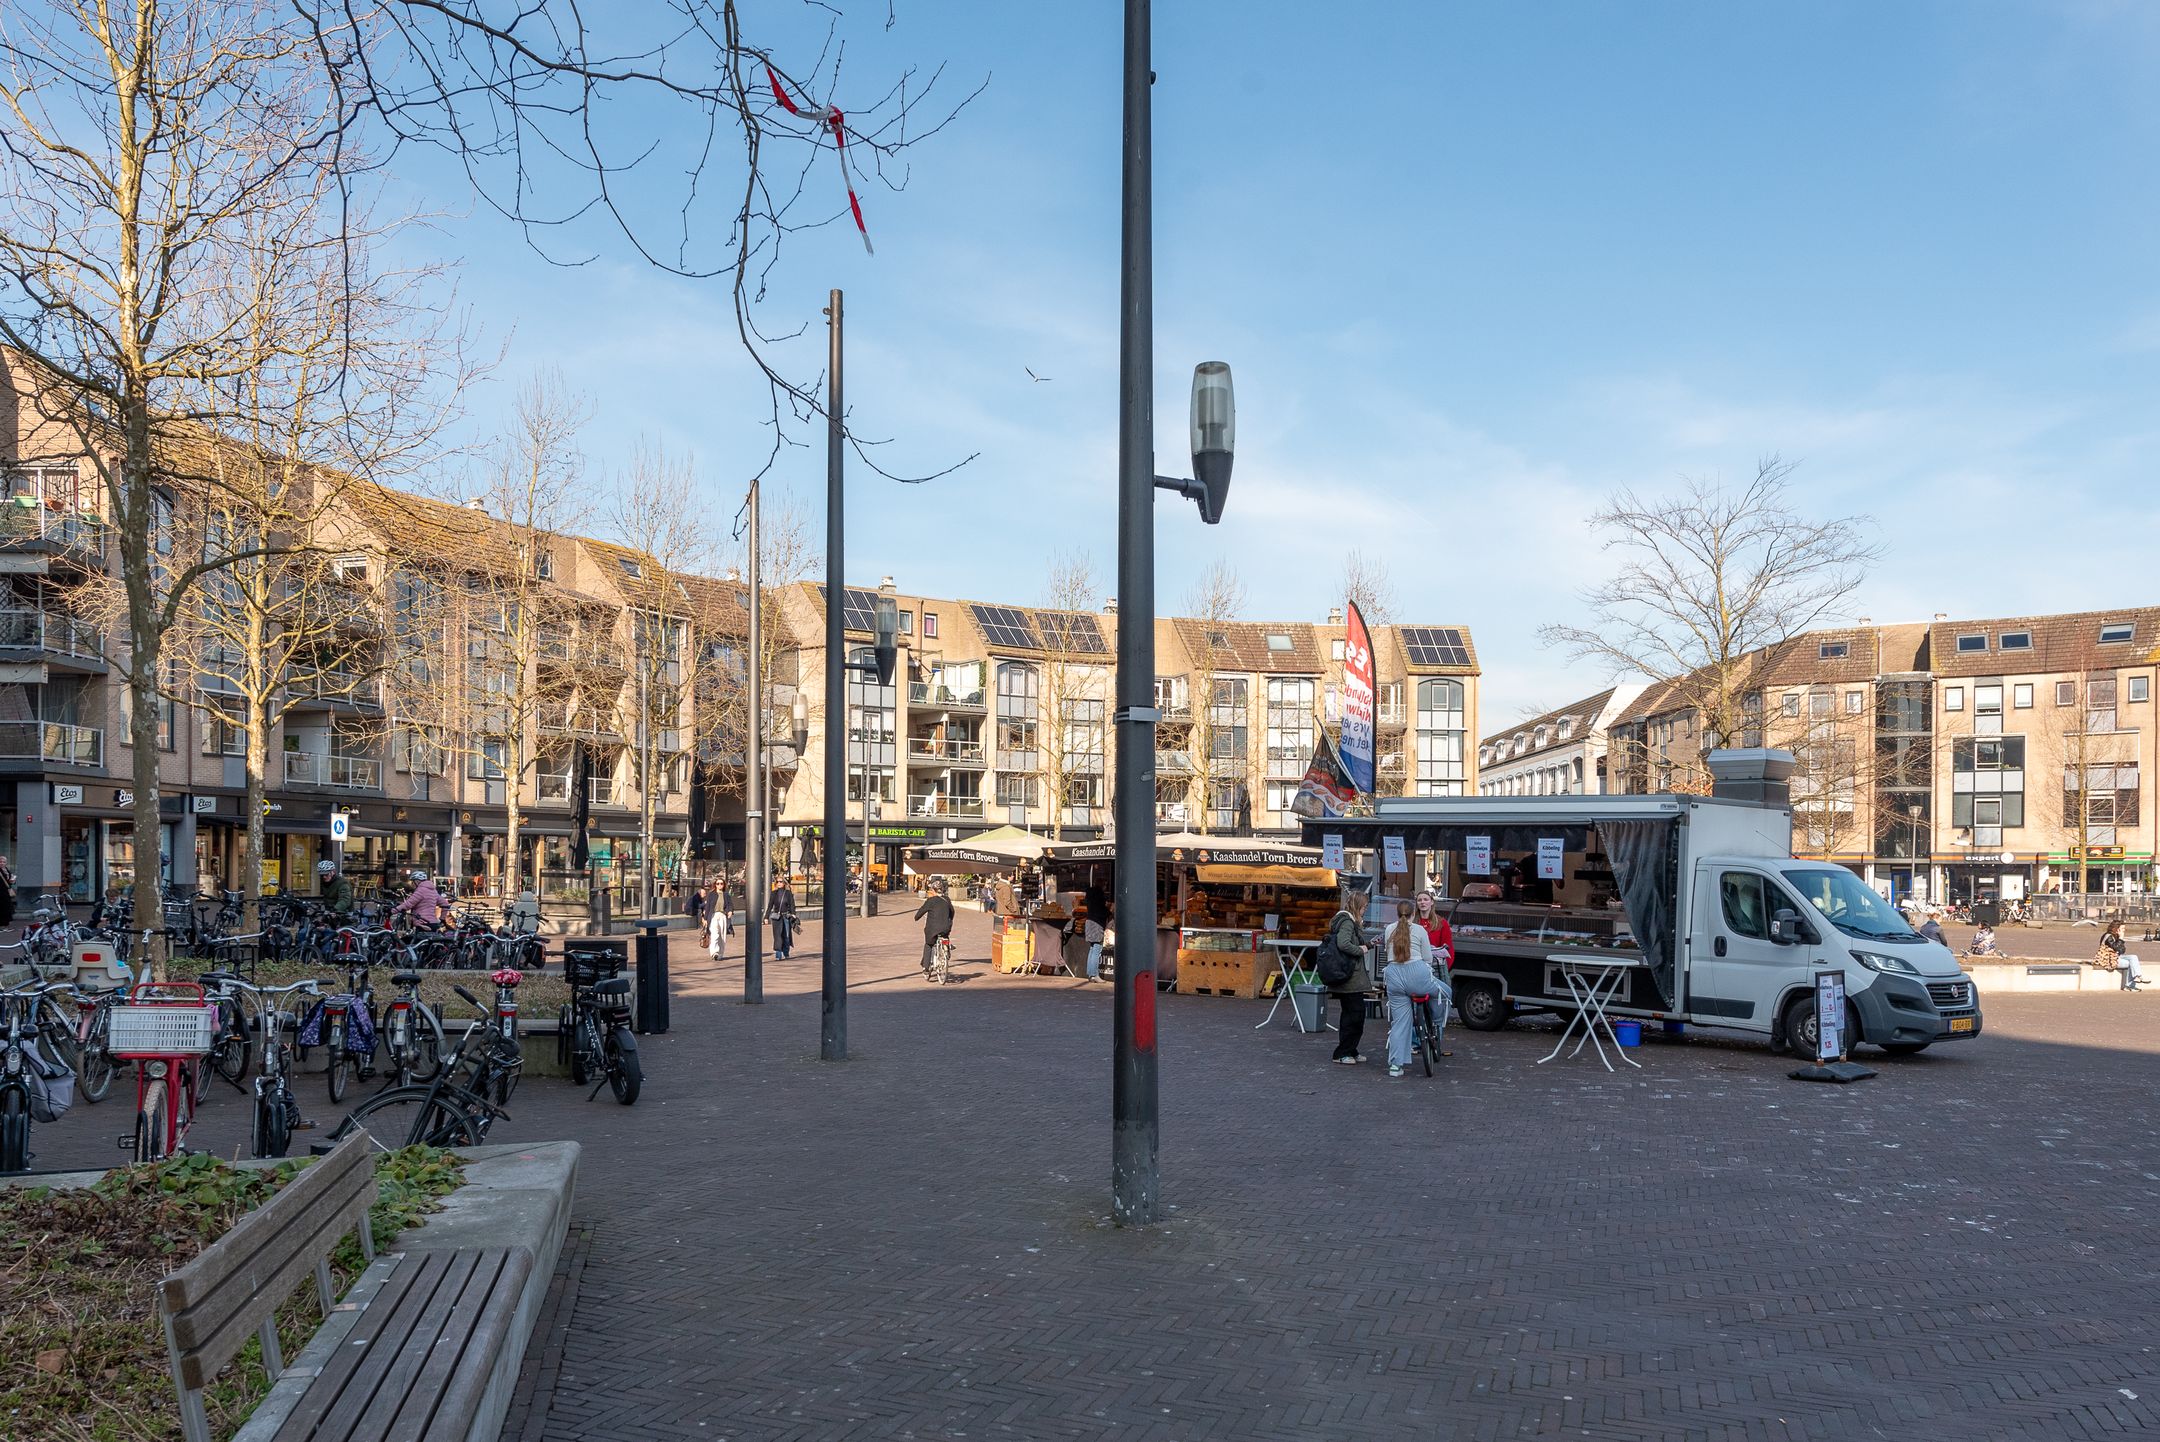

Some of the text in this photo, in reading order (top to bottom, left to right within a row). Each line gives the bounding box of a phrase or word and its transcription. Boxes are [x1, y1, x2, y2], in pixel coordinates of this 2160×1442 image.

[60, 787, 77, 799] Etos
[119, 789, 134, 804] Etos
[198, 798, 212, 809] Etos
[878, 828, 907, 836] BARISTA
[927, 849, 999, 863] Kaashandel Torn Broers
[1072, 846, 1115, 857] Kaashandel To
[1213, 851, 1261, 862] Kaashandel
[1262, 852, 1285, 863] Torn
[1287, 853, 1318, 865] Broers
